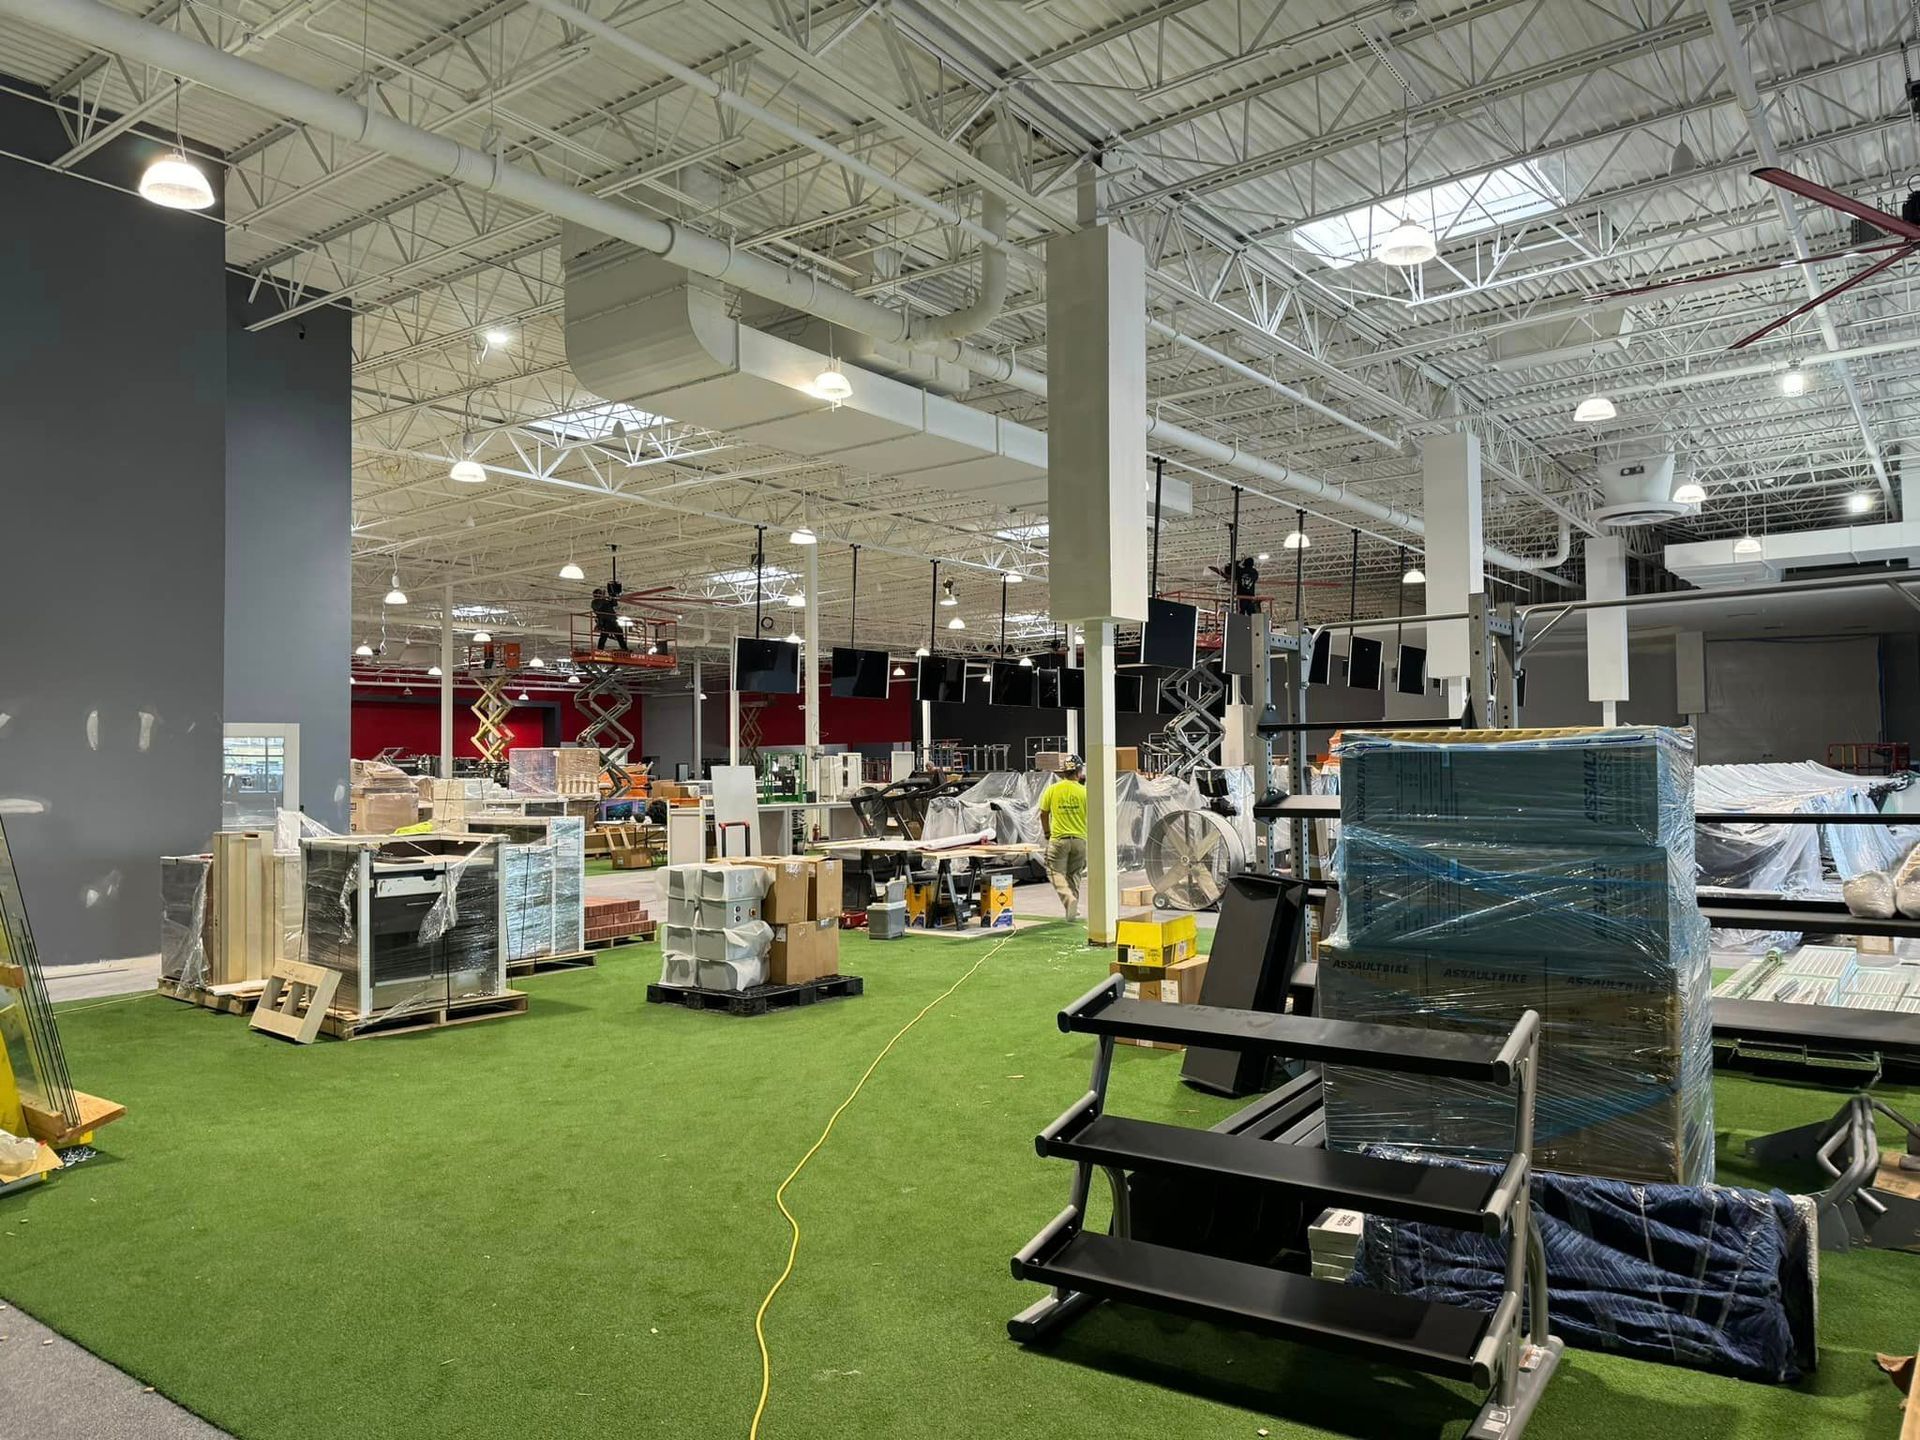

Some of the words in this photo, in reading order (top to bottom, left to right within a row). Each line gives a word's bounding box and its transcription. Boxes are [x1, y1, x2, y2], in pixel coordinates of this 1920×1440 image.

[1584, 749, 1597, 824] ASSAULT
[1333, 960, 1408, 974] ASSAULTBIKE
[1567, 976, 1656, 994] ASSAULTBIK
